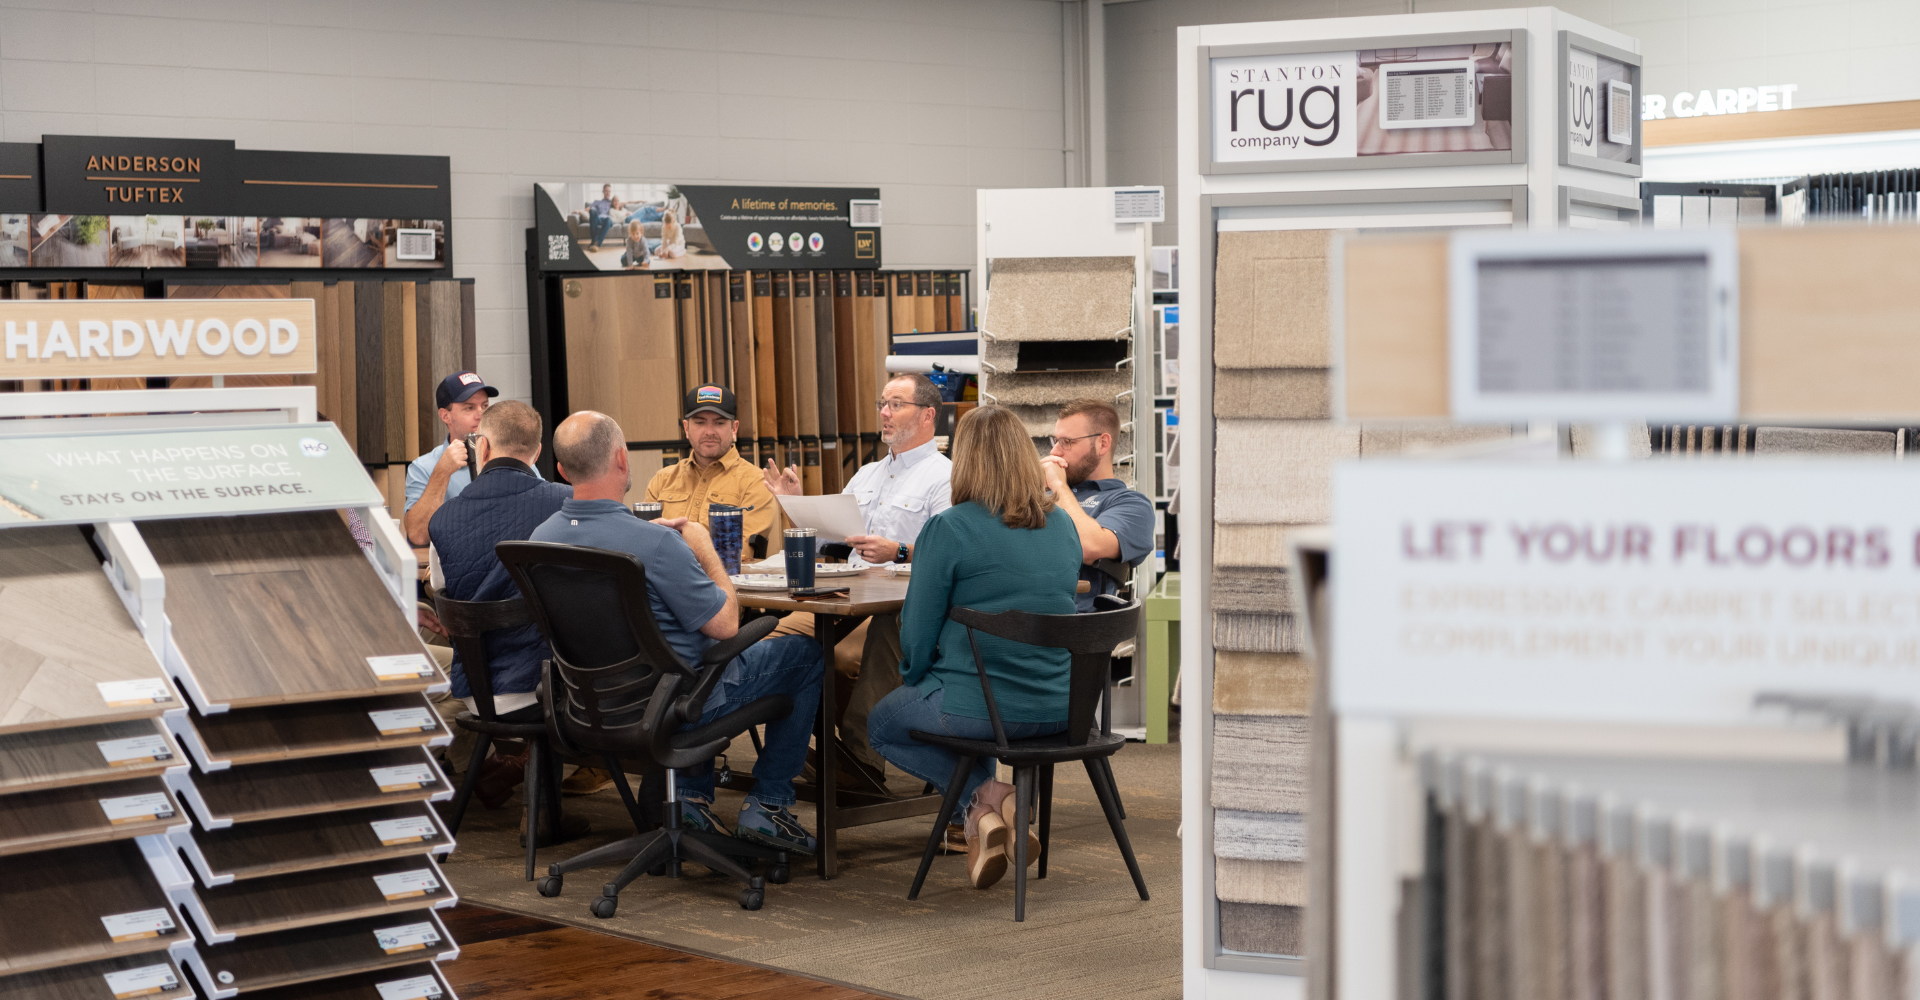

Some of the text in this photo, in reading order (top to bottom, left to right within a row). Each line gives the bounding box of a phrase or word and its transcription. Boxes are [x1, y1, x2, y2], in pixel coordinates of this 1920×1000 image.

[1230, 64, 1342, 83] STANTON
[1570, 81, 1594, 147] ug
[1672, 83, 1798, 118] CARPET
[1230, 85, 1340, 146] rug
[1230, 134, 1300, 150] company
[86, 155, 201, 173] ANDERSON
[105, 186, 184, 203] TUFTEX
[731, 198, 838, 211] A lifetime of memories.
[4, 318, 299, 360] HARDWOOD
[48, 443, 288, 470] WHAT HAPPENS ON
[128, 461, 302, 485] THE SURFACE,
[60, 482, 313, 507] STAYS ON THE SURFACE.
[1400, 522, 1488, 561] LET
[1509, 523, 1653, 564] YOUR
[1674, 526, 1891, 567] FLOORS
[1627, 589, 1777, 621] CARPET
[1790, 591, 1920, 625] SELEC
[1402, 625, 1644, 658] COMPLEMENT
[1661, 630, 1764, 662] YOUR
